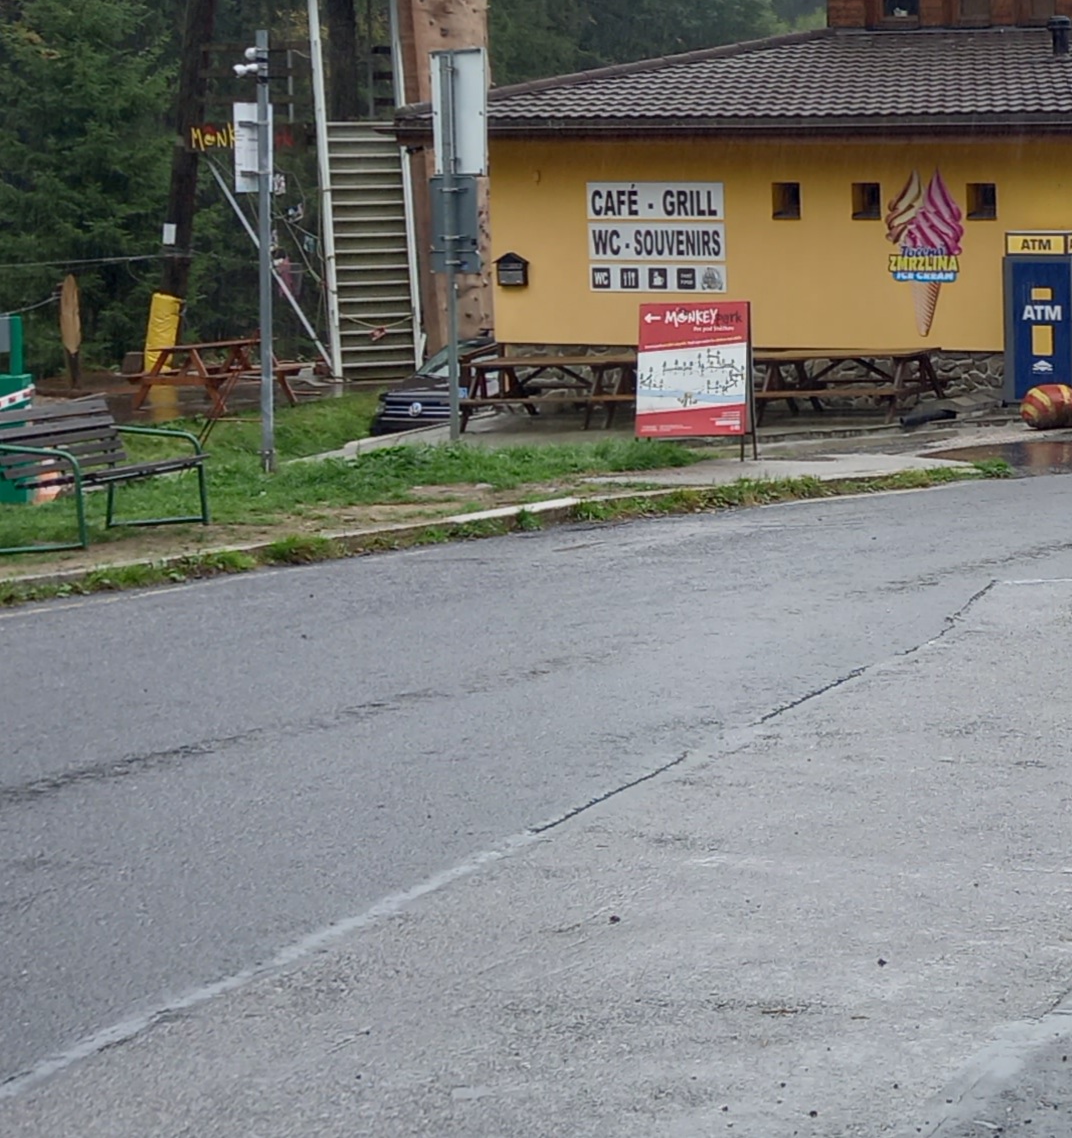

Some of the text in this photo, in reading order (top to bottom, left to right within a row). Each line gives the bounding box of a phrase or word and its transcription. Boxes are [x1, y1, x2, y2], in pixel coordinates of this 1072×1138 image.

[591, 183, 639, 216] CAFÉ
[662, 189, 718, 217] GRILL
[1020, 238, 1052, 252] ATM
[889, 255, 959, 272] ZMRZLINA
[594, 271, 609, 285] WC
[664, 308, 719, 328] MONKEY
[1022, 305, 1063, 321] ATM
